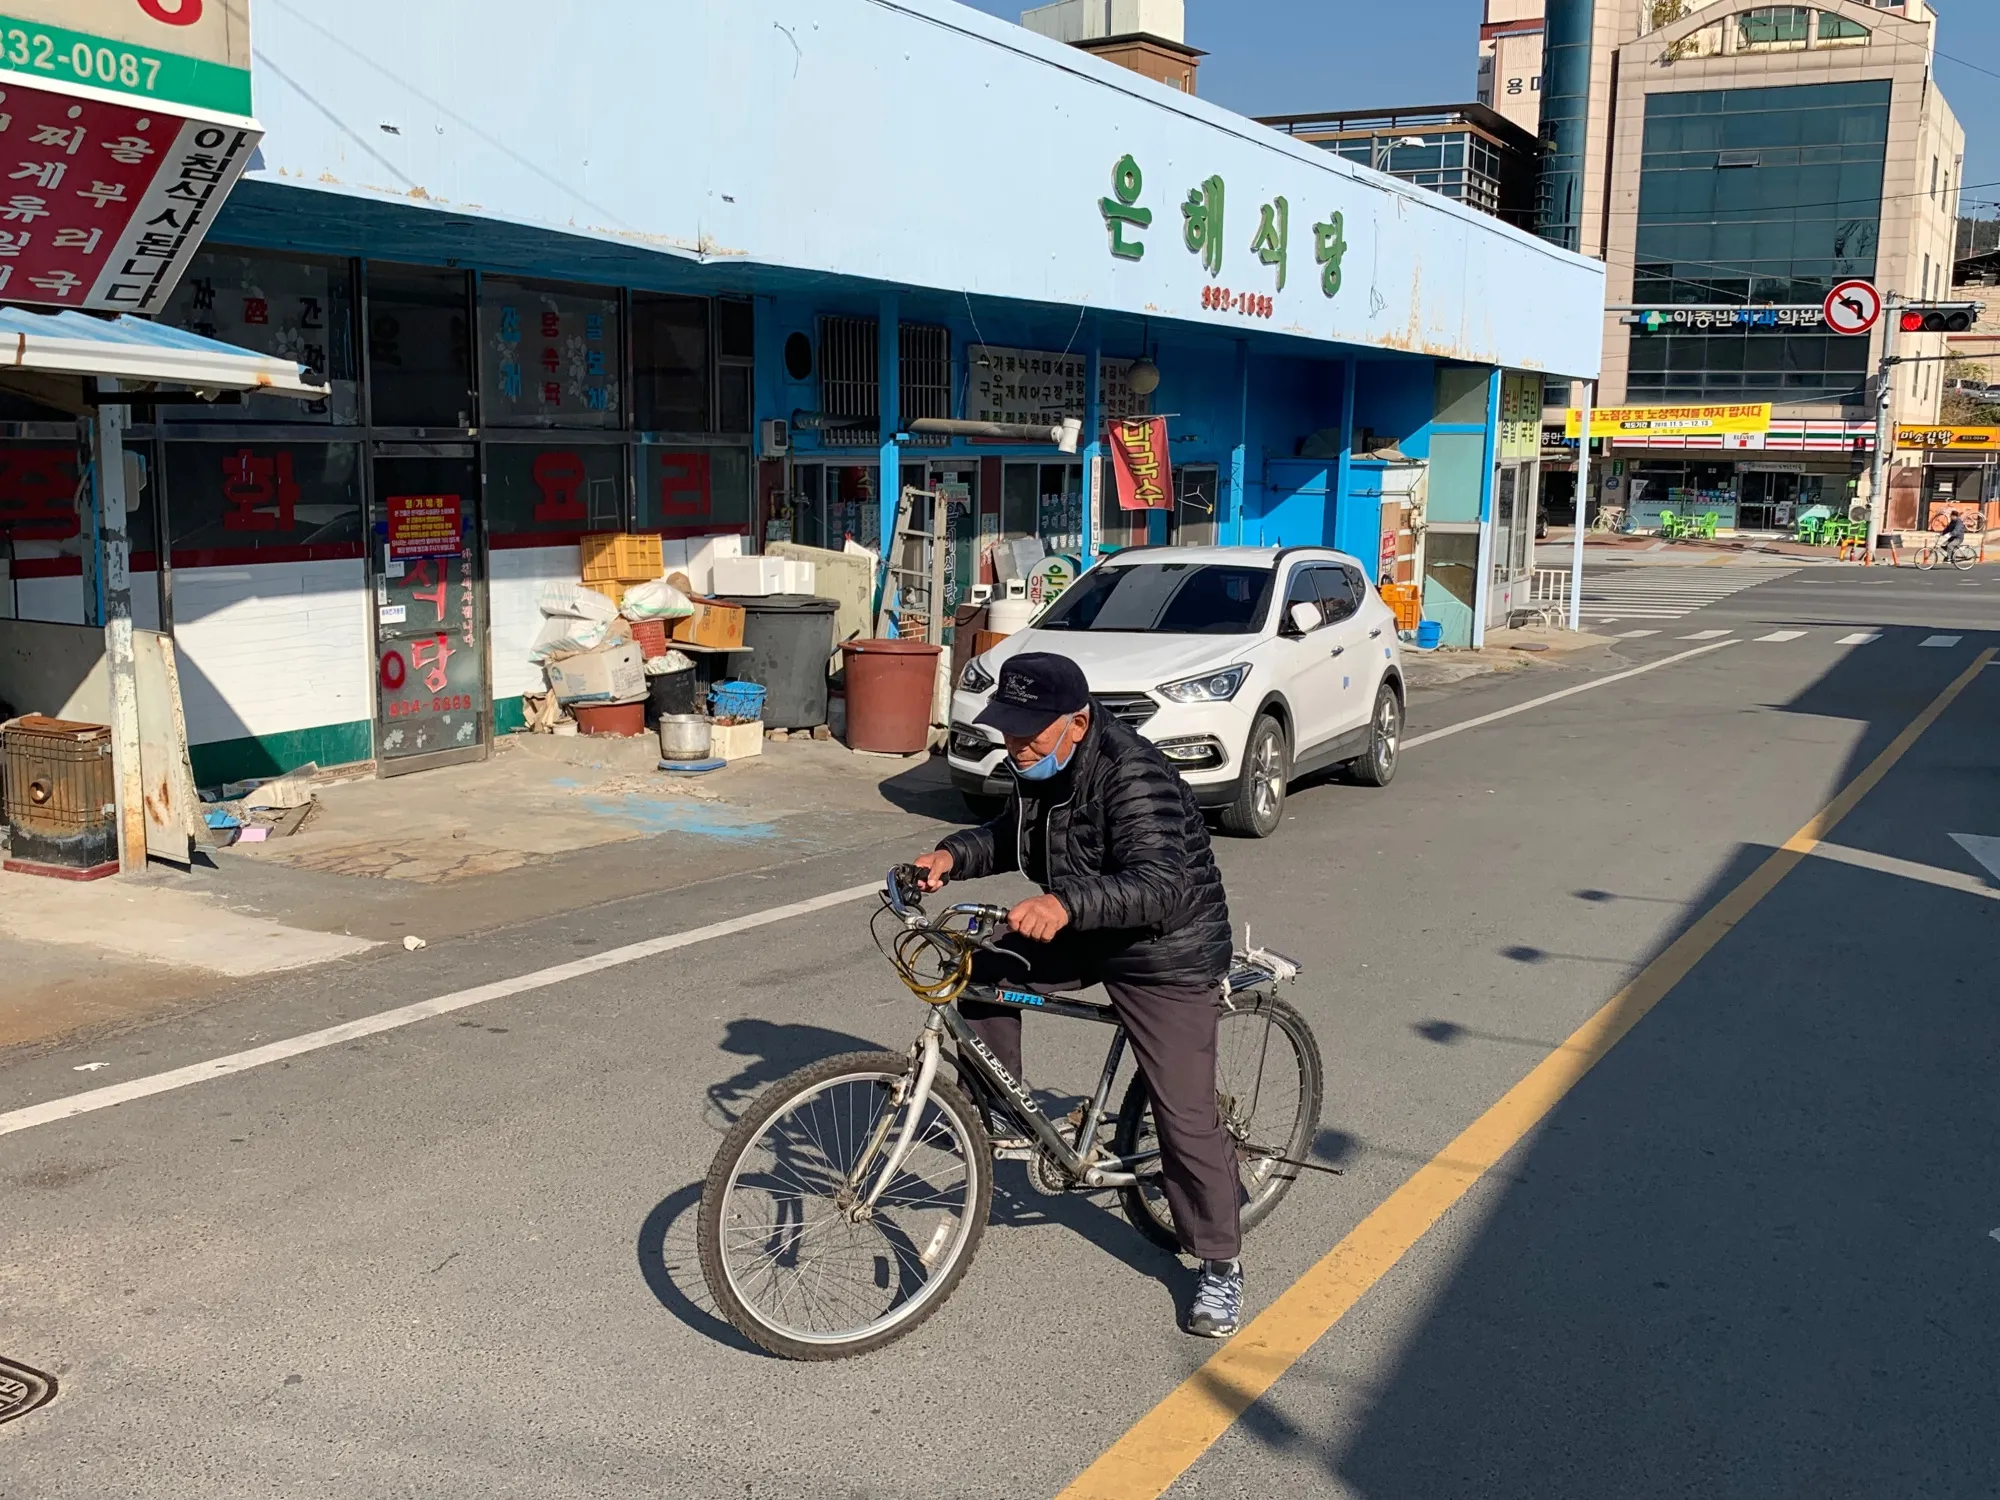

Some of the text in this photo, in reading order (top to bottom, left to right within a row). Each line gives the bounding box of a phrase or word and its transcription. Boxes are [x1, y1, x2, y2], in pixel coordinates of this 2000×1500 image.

[0, 27, 161, 90] 32-0087
[28, 136, 155, 296] 골부리국
[1098, 153, 1347, 298] 은혜식당
[541, 311, 560, 405] 탕수육
[1065, 362, 1074, 419] 골부리
[1600, 409, 1631, 421] 노점상
[1635, 409, 1644, 420] 및
[1704, 407, 1724, 418] 하지
[1729, 405, 1762, 417] 맙시다
[1123, 420, 1166, 507] 막국수
[1542, 431, 1581, 449] 중만치
[1901, 430, 1953, 445] 미소김밥
[1003, 991, 1043, 1006] EIFFEL
[970, 1036, 1038, 1113] LESPO
